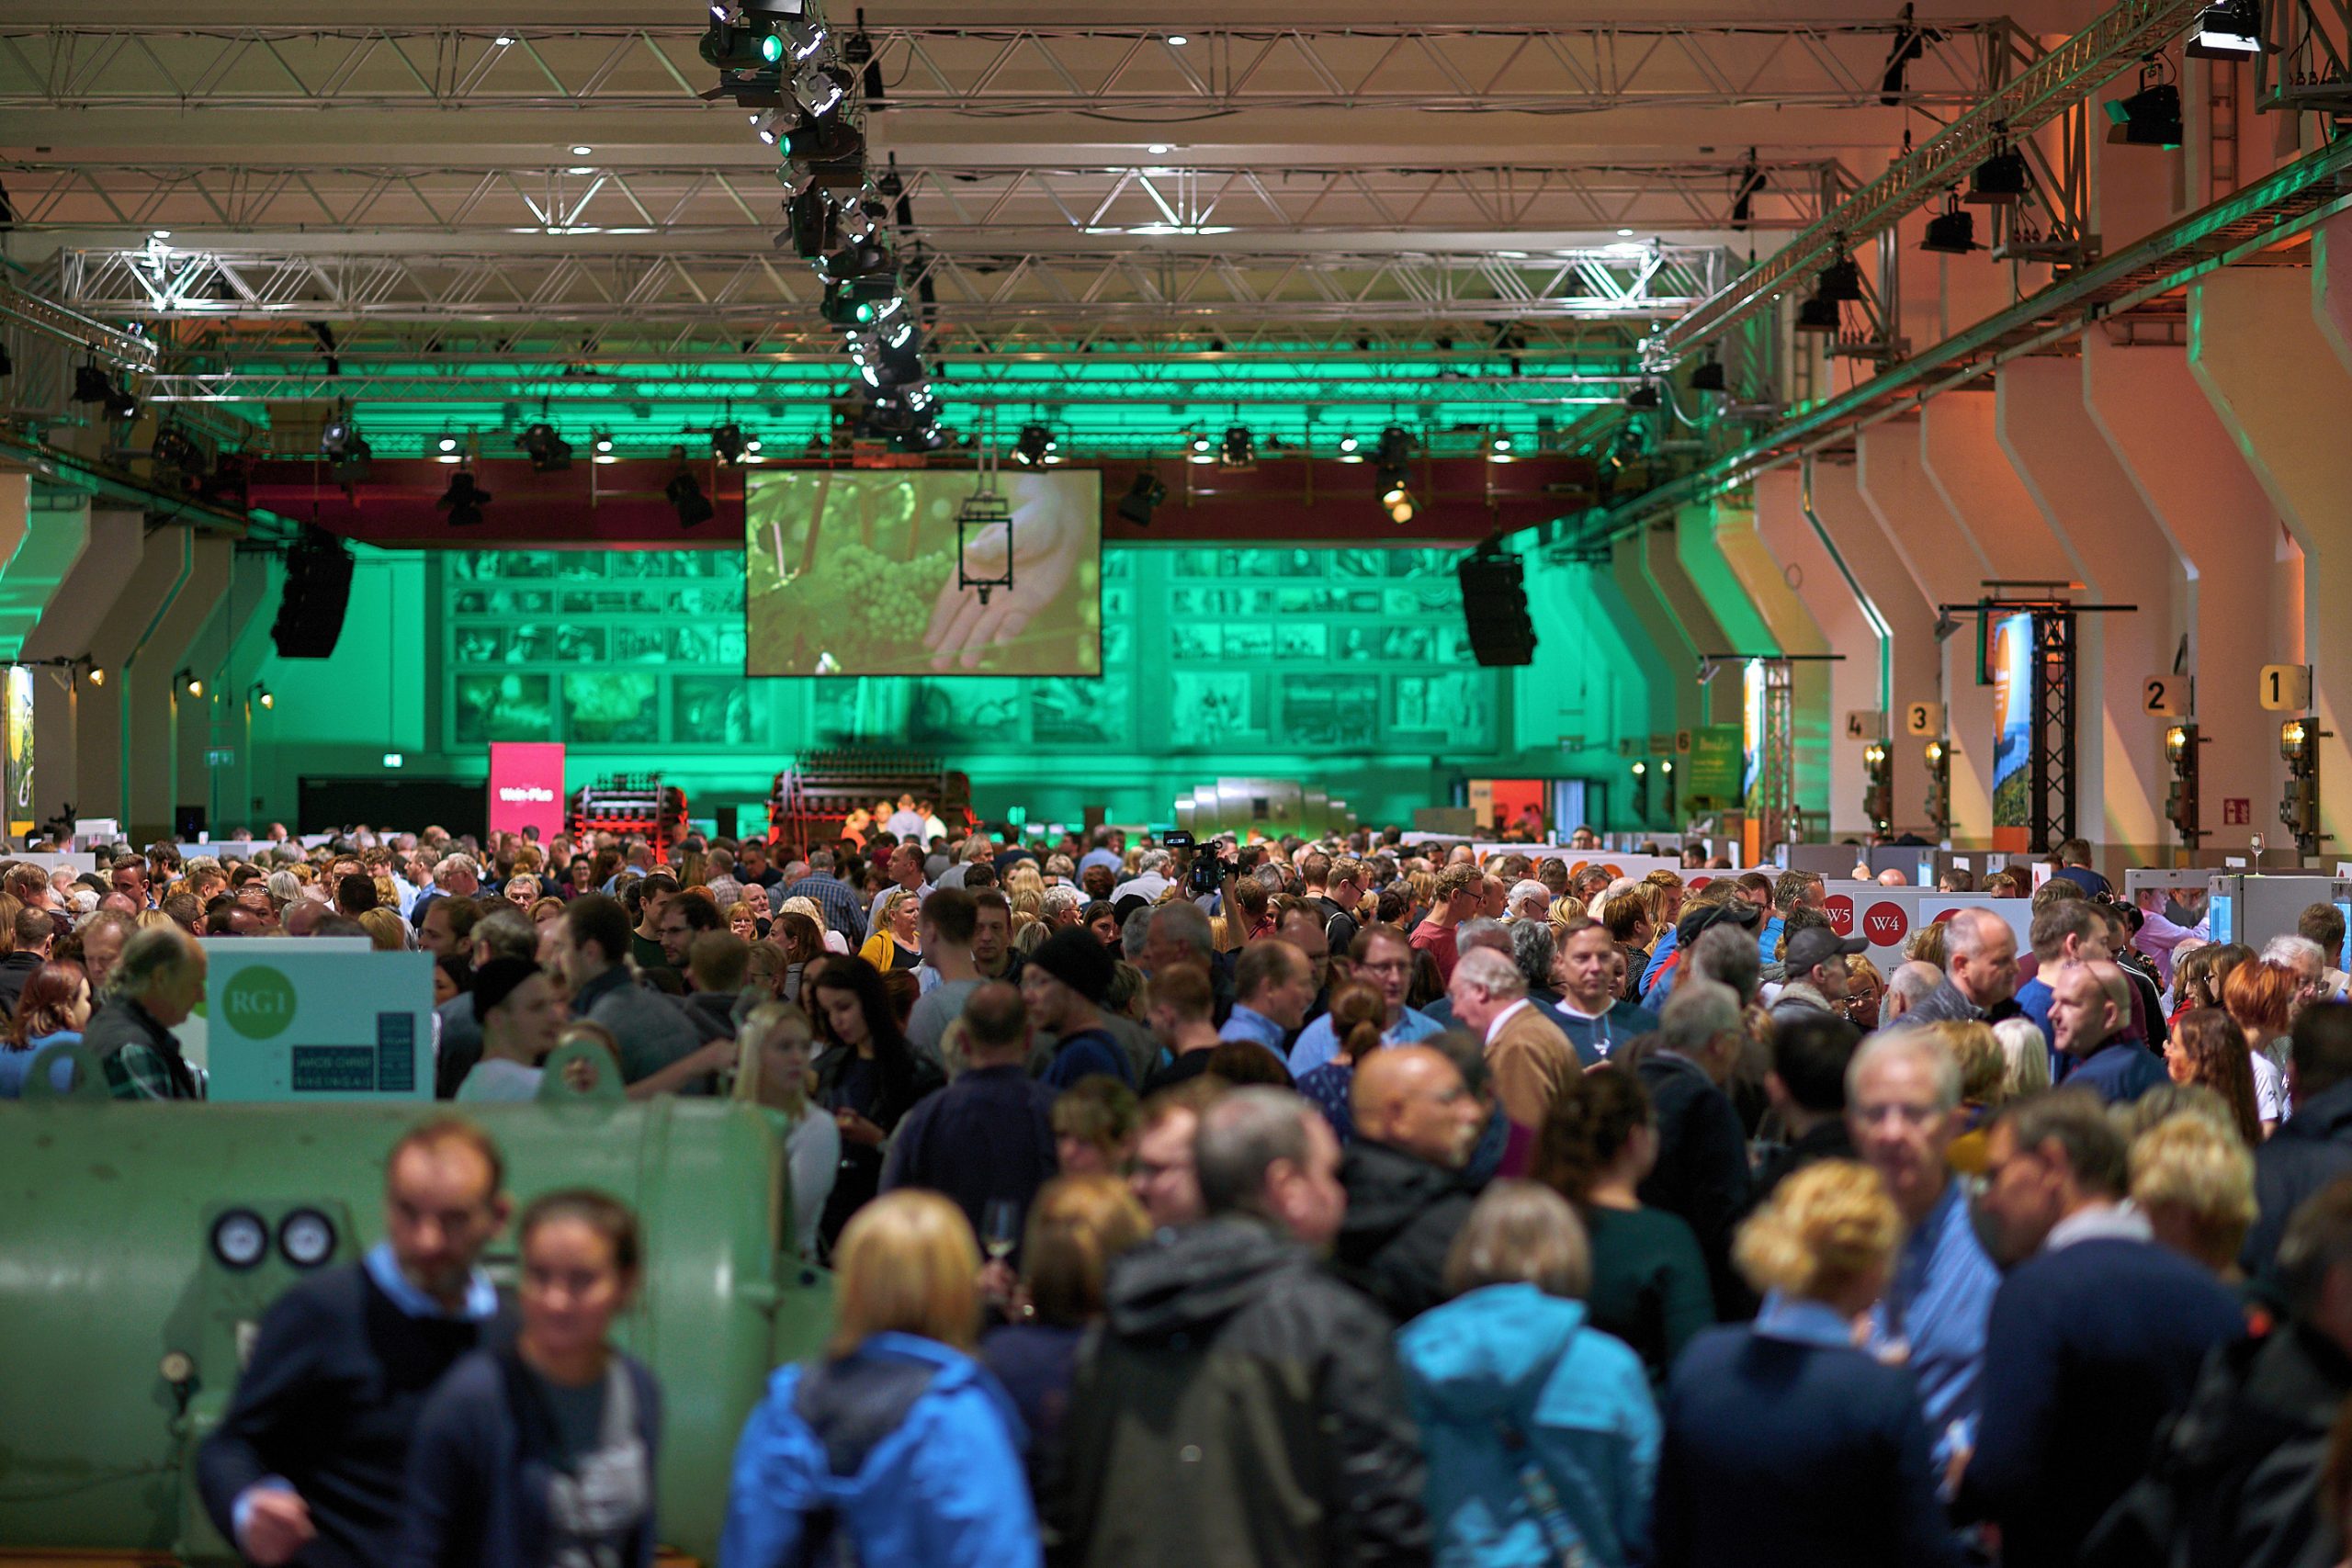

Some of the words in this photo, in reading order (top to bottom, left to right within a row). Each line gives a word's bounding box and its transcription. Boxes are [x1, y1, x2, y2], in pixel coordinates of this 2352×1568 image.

[2148, 682, 2165, 709] 2
[2269, 671, 2279, 703] 1
[1849, 715, 1861, 736] 4
[1913, 706, 1927, 729] 3
[1826, 908, 1851, 923] W5
[1871, 915, 1900, 931] W4
